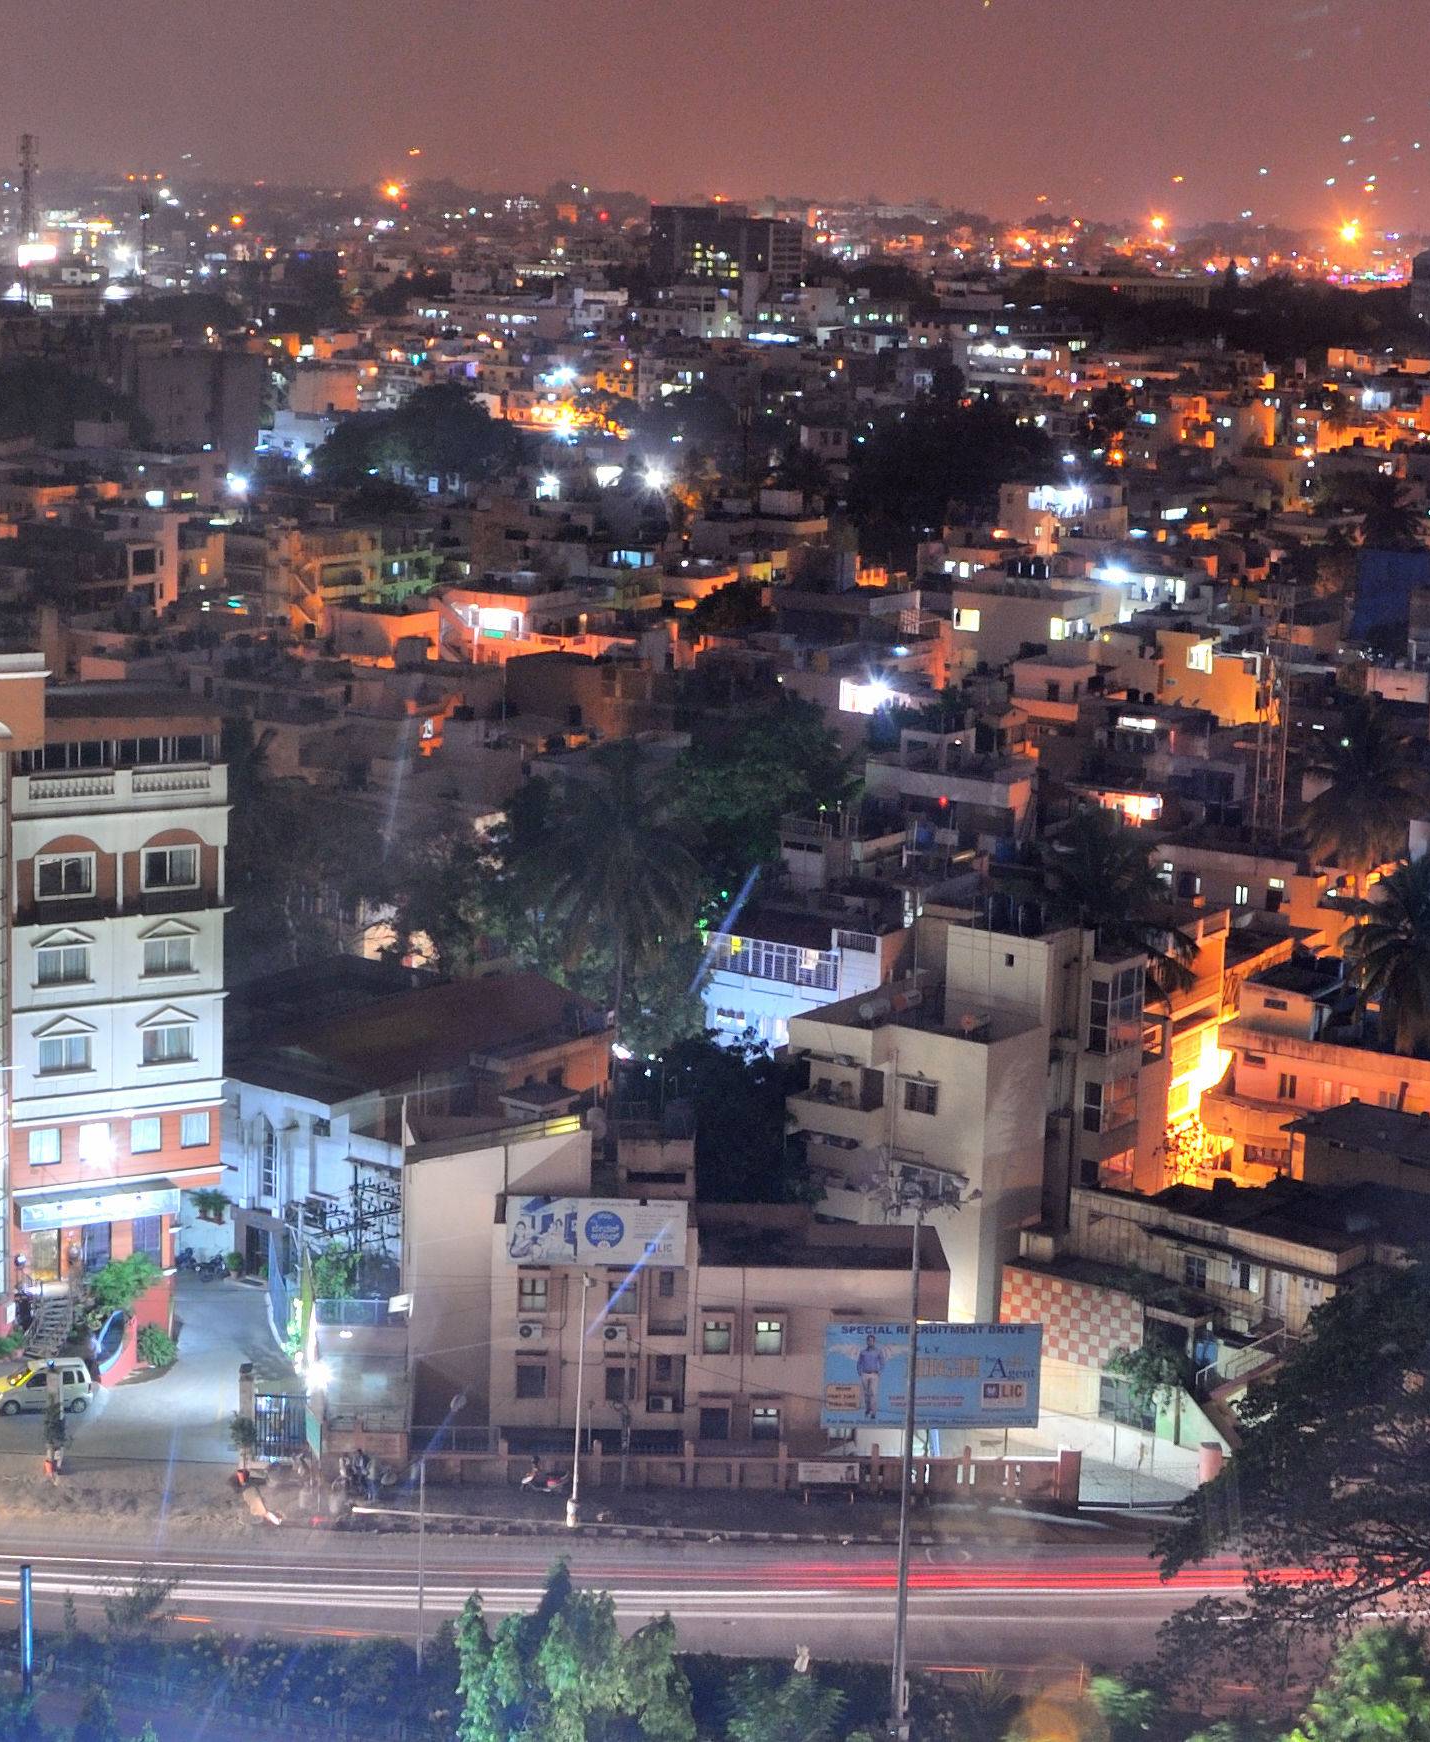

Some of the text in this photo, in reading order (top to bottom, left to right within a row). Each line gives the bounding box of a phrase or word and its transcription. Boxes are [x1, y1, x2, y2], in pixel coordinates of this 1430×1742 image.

[841, 1325, 1025, 1335] SPECIAL RECRUITMENT DRIVE
[987, 1357, 1035, 1380] Agent
[1003, 1384, 1023, 1398] LIC
